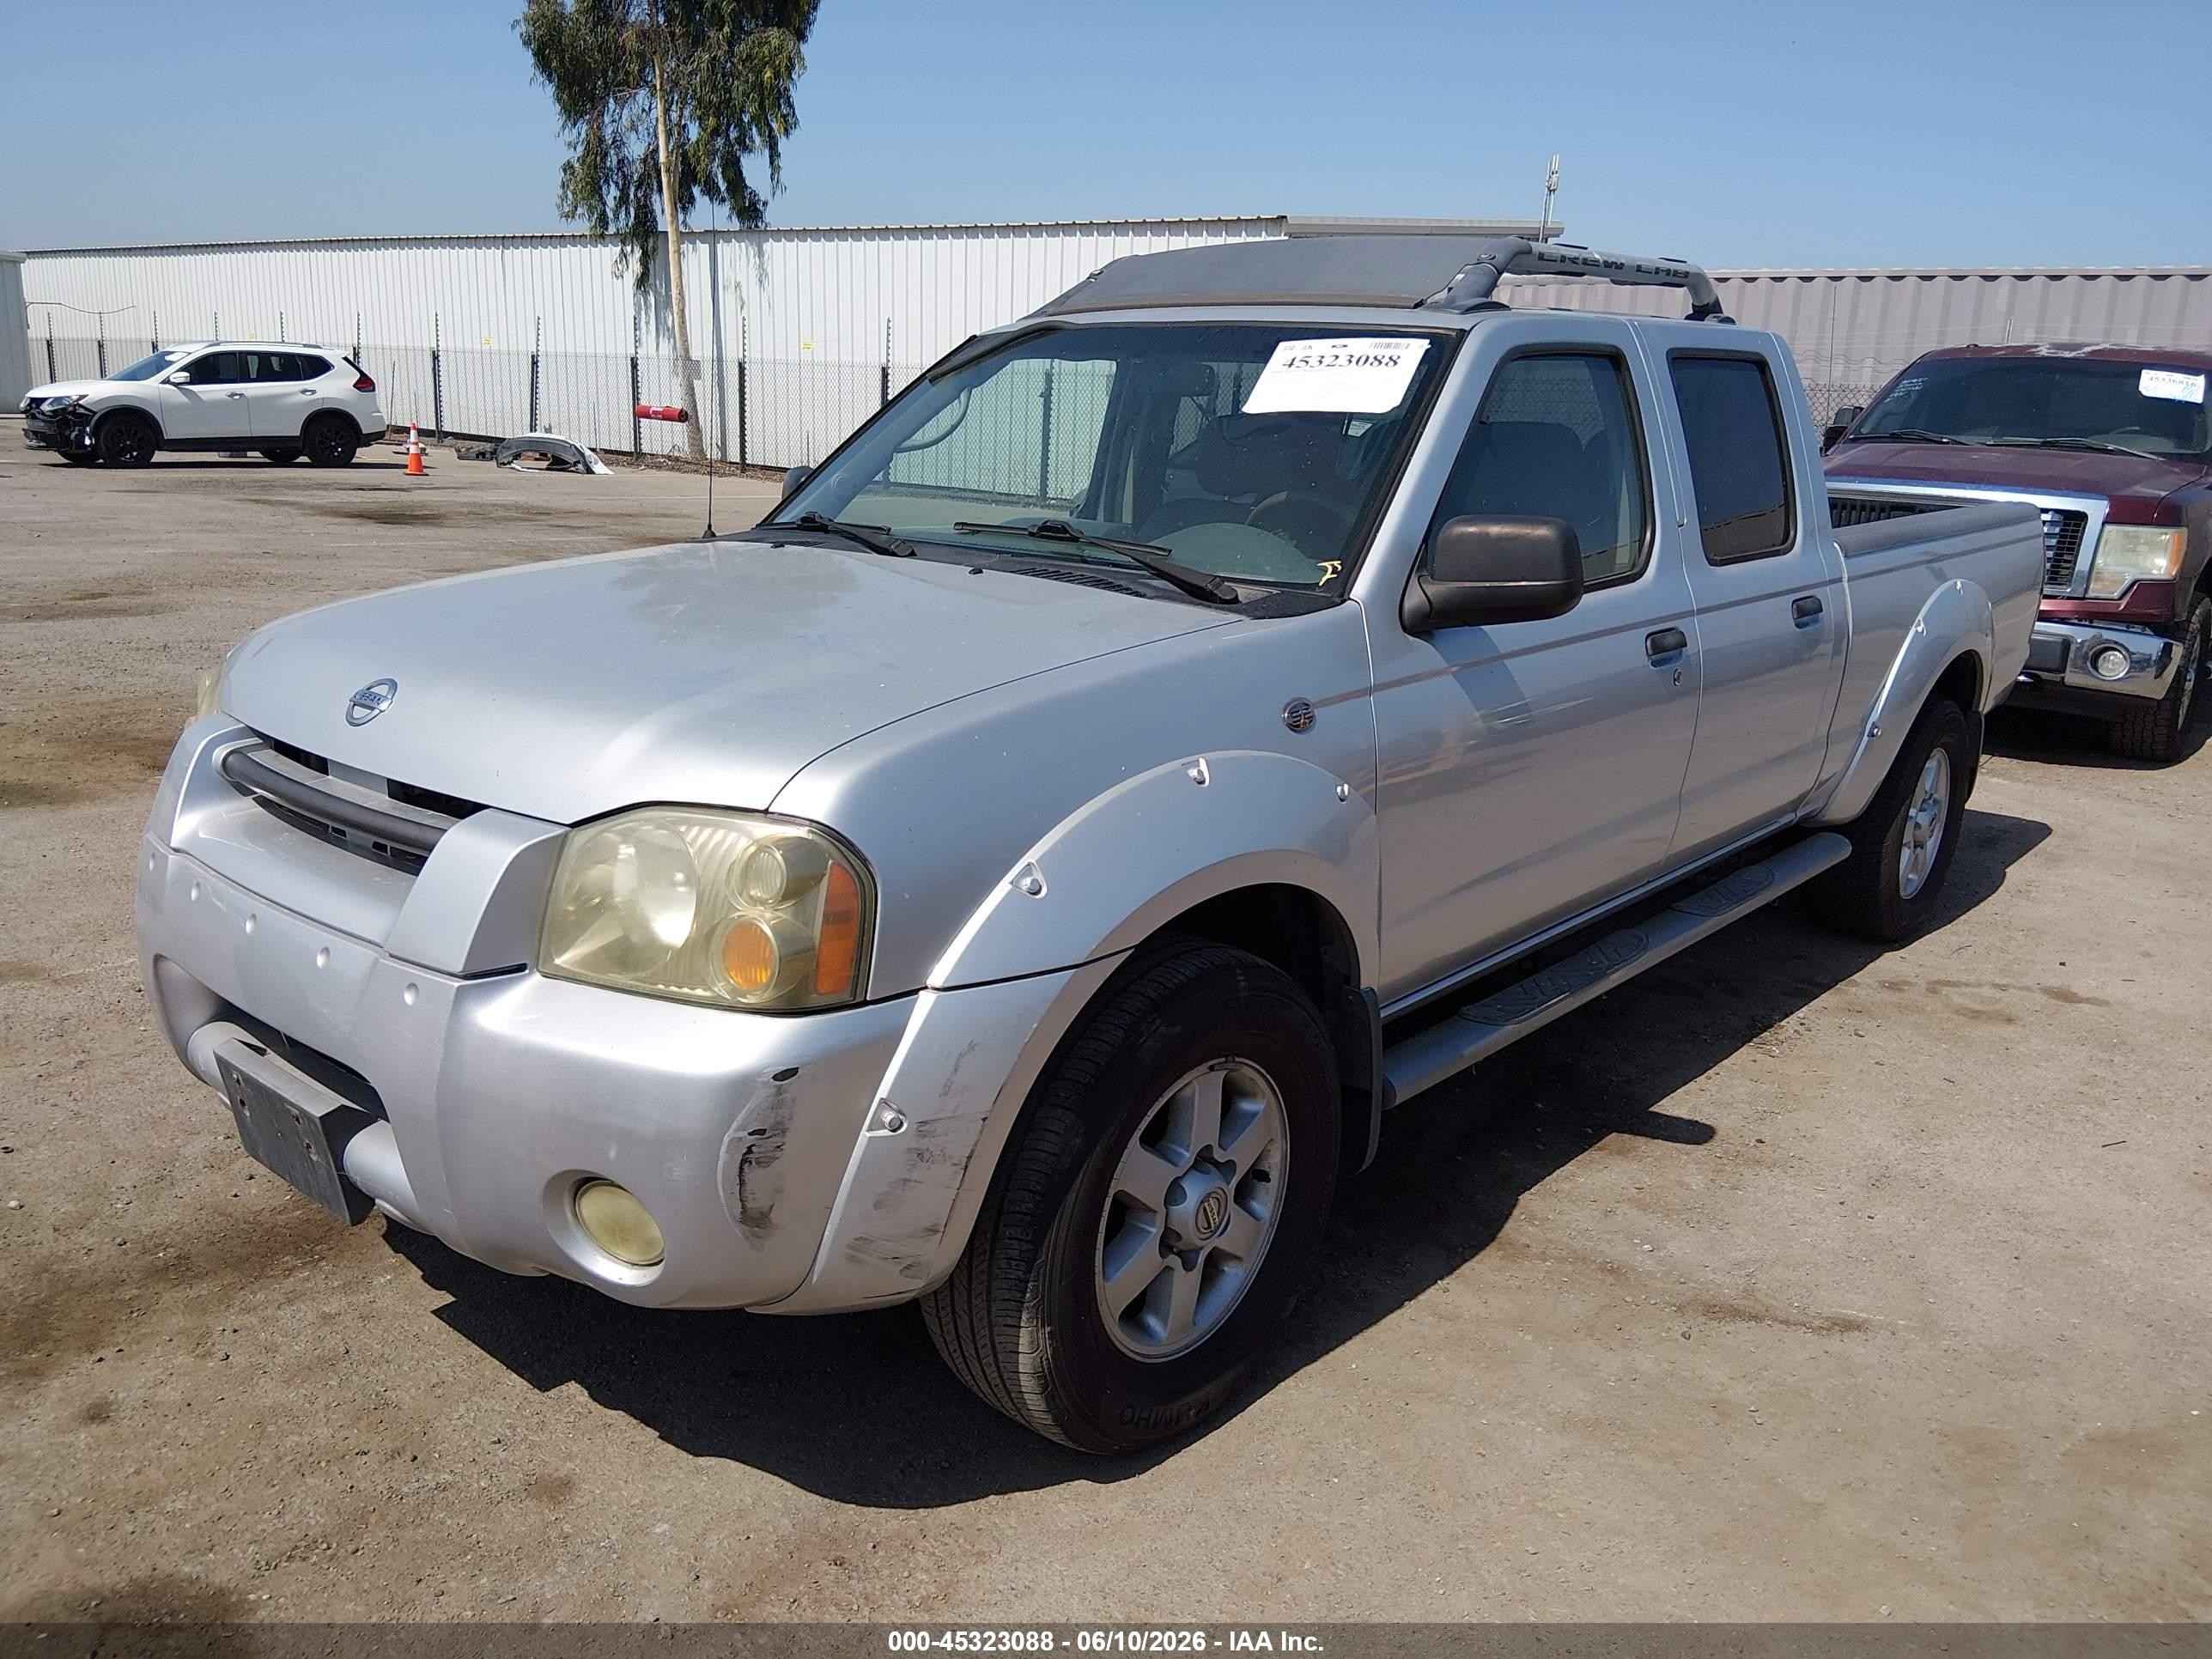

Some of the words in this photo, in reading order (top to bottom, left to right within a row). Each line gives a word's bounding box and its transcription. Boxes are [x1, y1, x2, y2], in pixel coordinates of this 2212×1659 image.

[1537, 251, 1626, 270] CREW
[1635, 263, 1691, 279] CAB
[1282, 354, 1401, 368] 45323088
